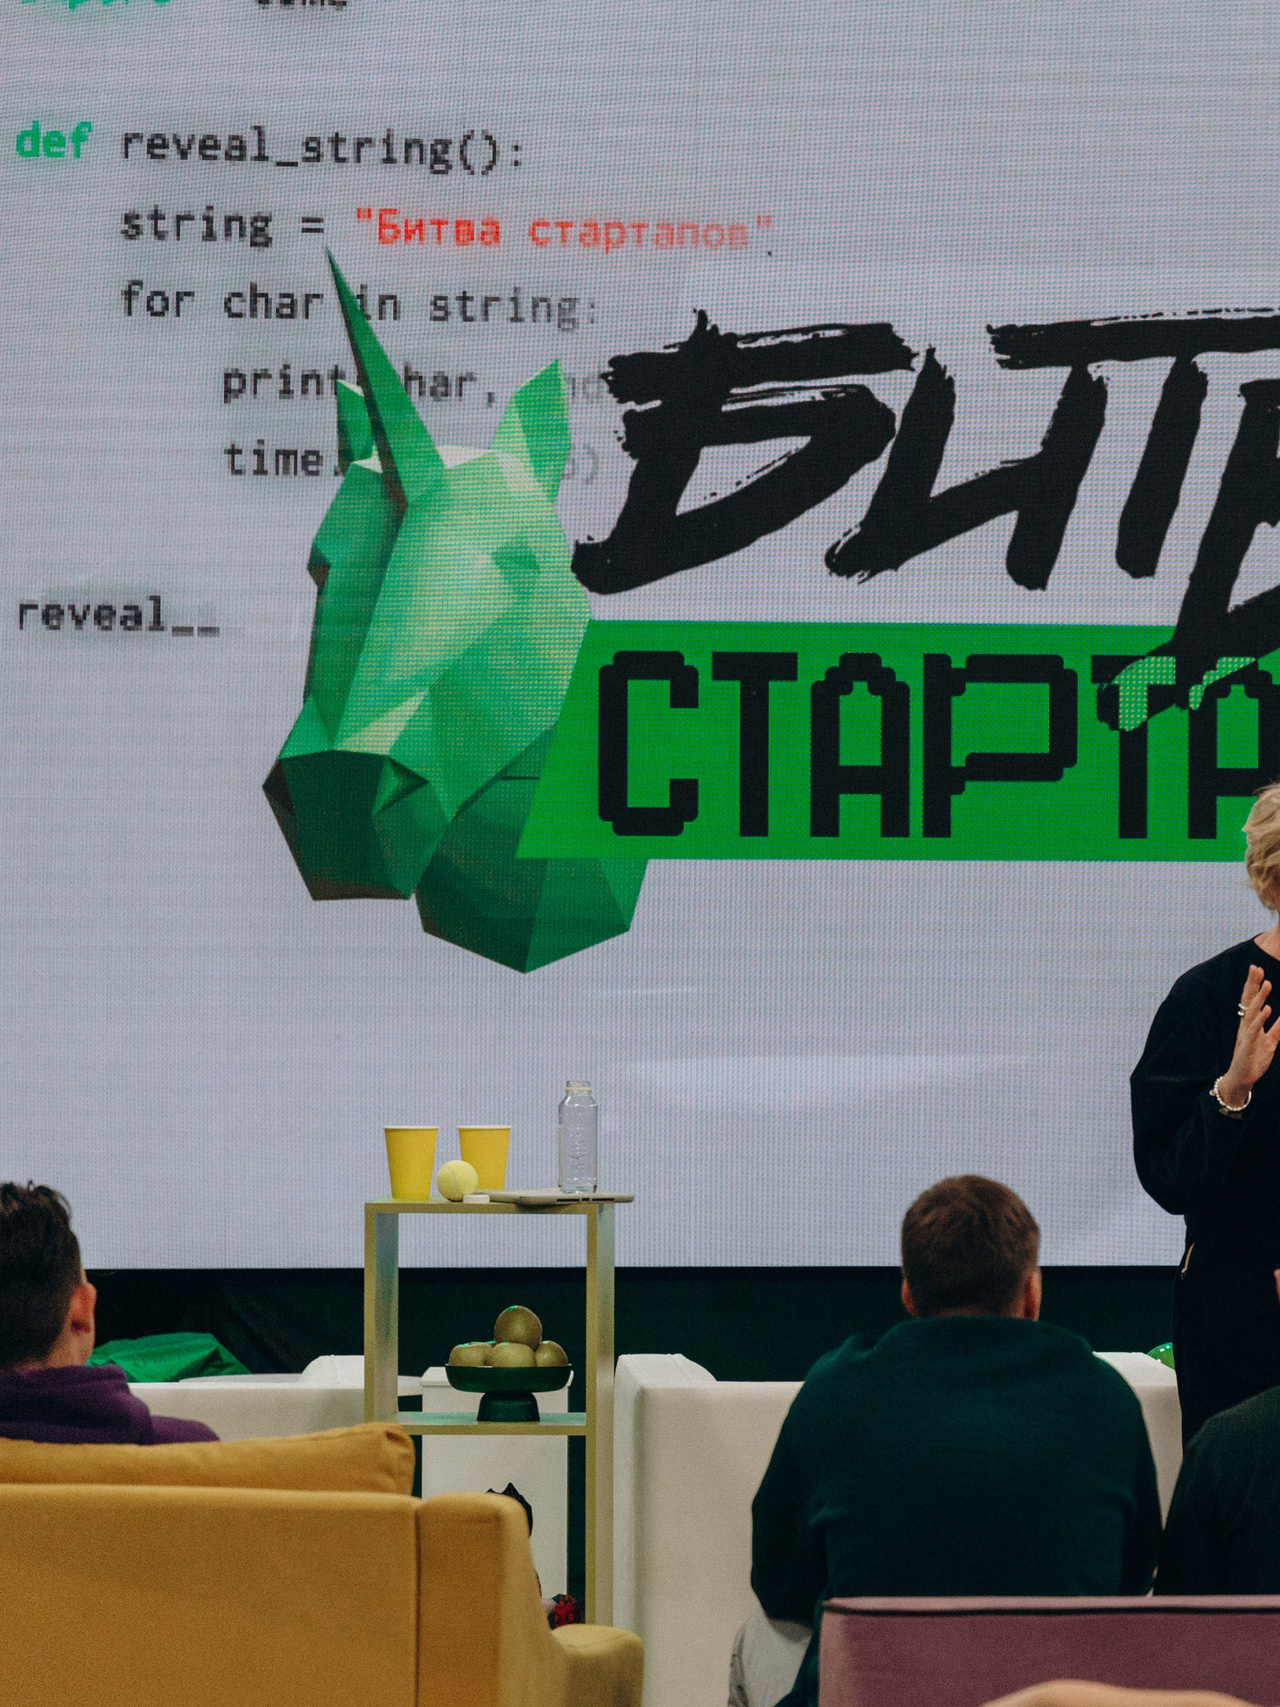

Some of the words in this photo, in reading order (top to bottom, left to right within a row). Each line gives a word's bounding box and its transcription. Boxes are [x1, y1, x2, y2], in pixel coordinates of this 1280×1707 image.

[15, 121, 93, 159] def
[121, 126, 523, 176] reveal_string():
[121, 207, 273, 248] string
[301, 216, 325, 235] =
[121, 281, 194, 319] for
[223, 282, 323, 321] char
[429, 288, 599, 330] string:
